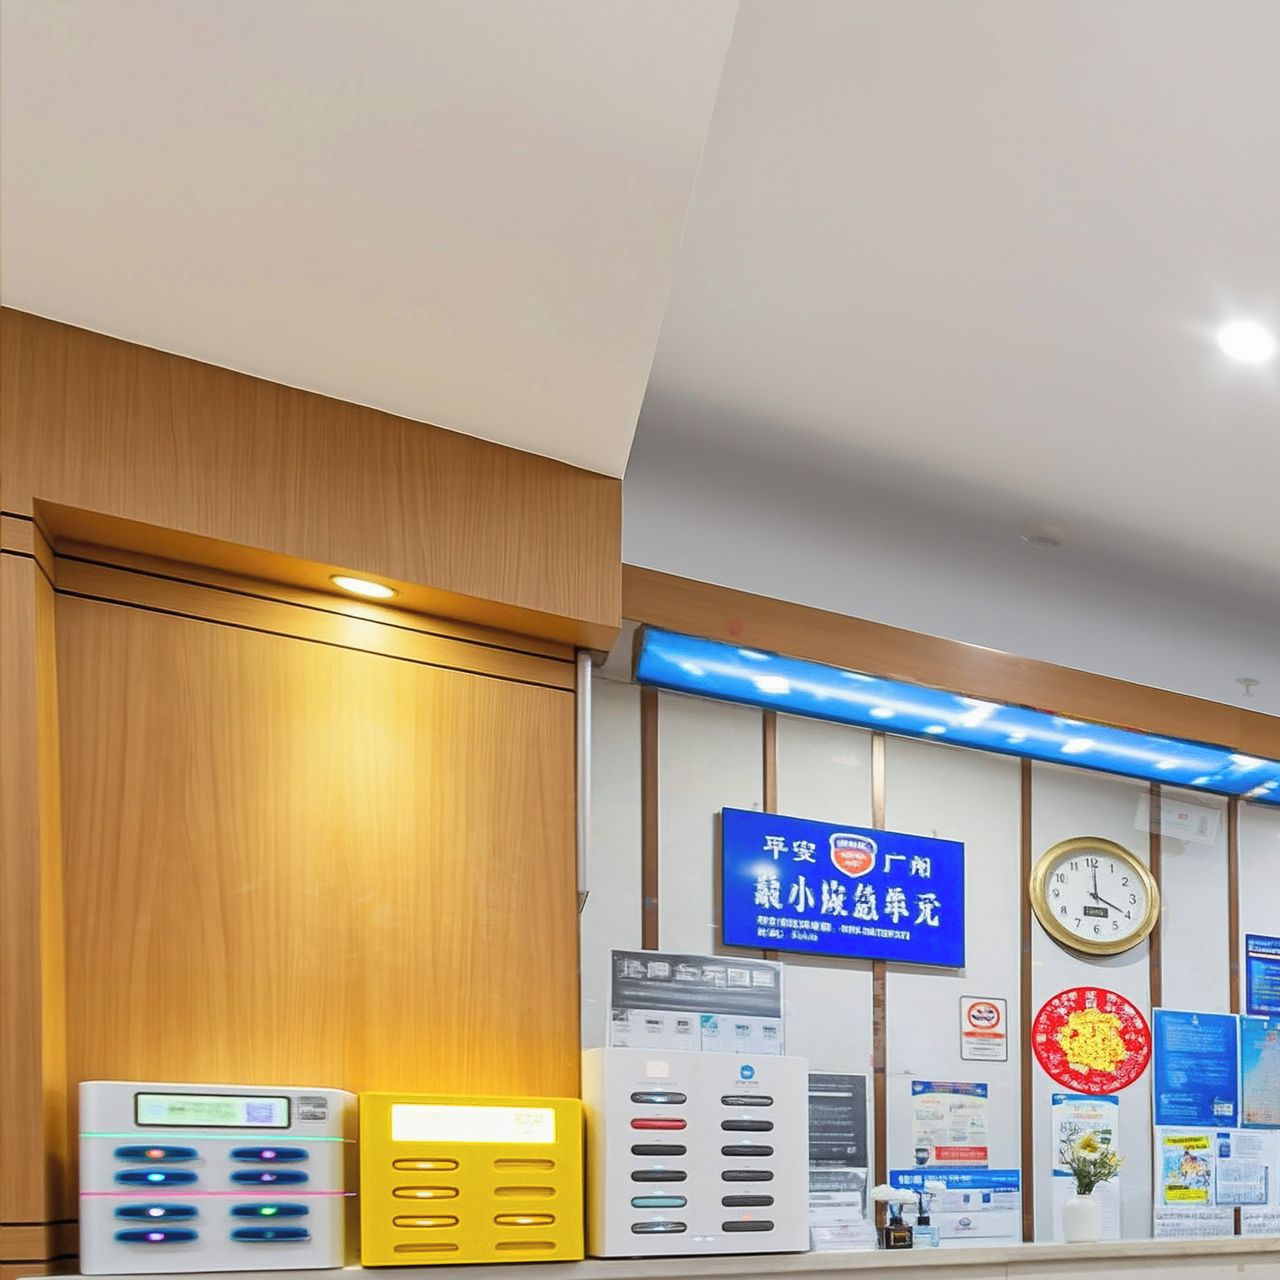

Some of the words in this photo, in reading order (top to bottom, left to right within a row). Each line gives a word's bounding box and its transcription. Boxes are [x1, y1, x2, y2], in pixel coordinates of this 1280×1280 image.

[1070, 862, 1078, 871] 11
[1086, 858, 1099, 868] 12
[1056, 873, 1065, 883] 10
[1122, 877, 1129, 887] 2
[1052, 889, 1060, 897] 9
[1129, 894, 1137, 905] 3
[1060, 905, 1067, 914] 8
[1124, 910, 1131, 919] 4
[1075, 918, 1081, 928] 7
[1112, 921, 1119, 930] 5
[1093, 924, 1100, 934] 6
